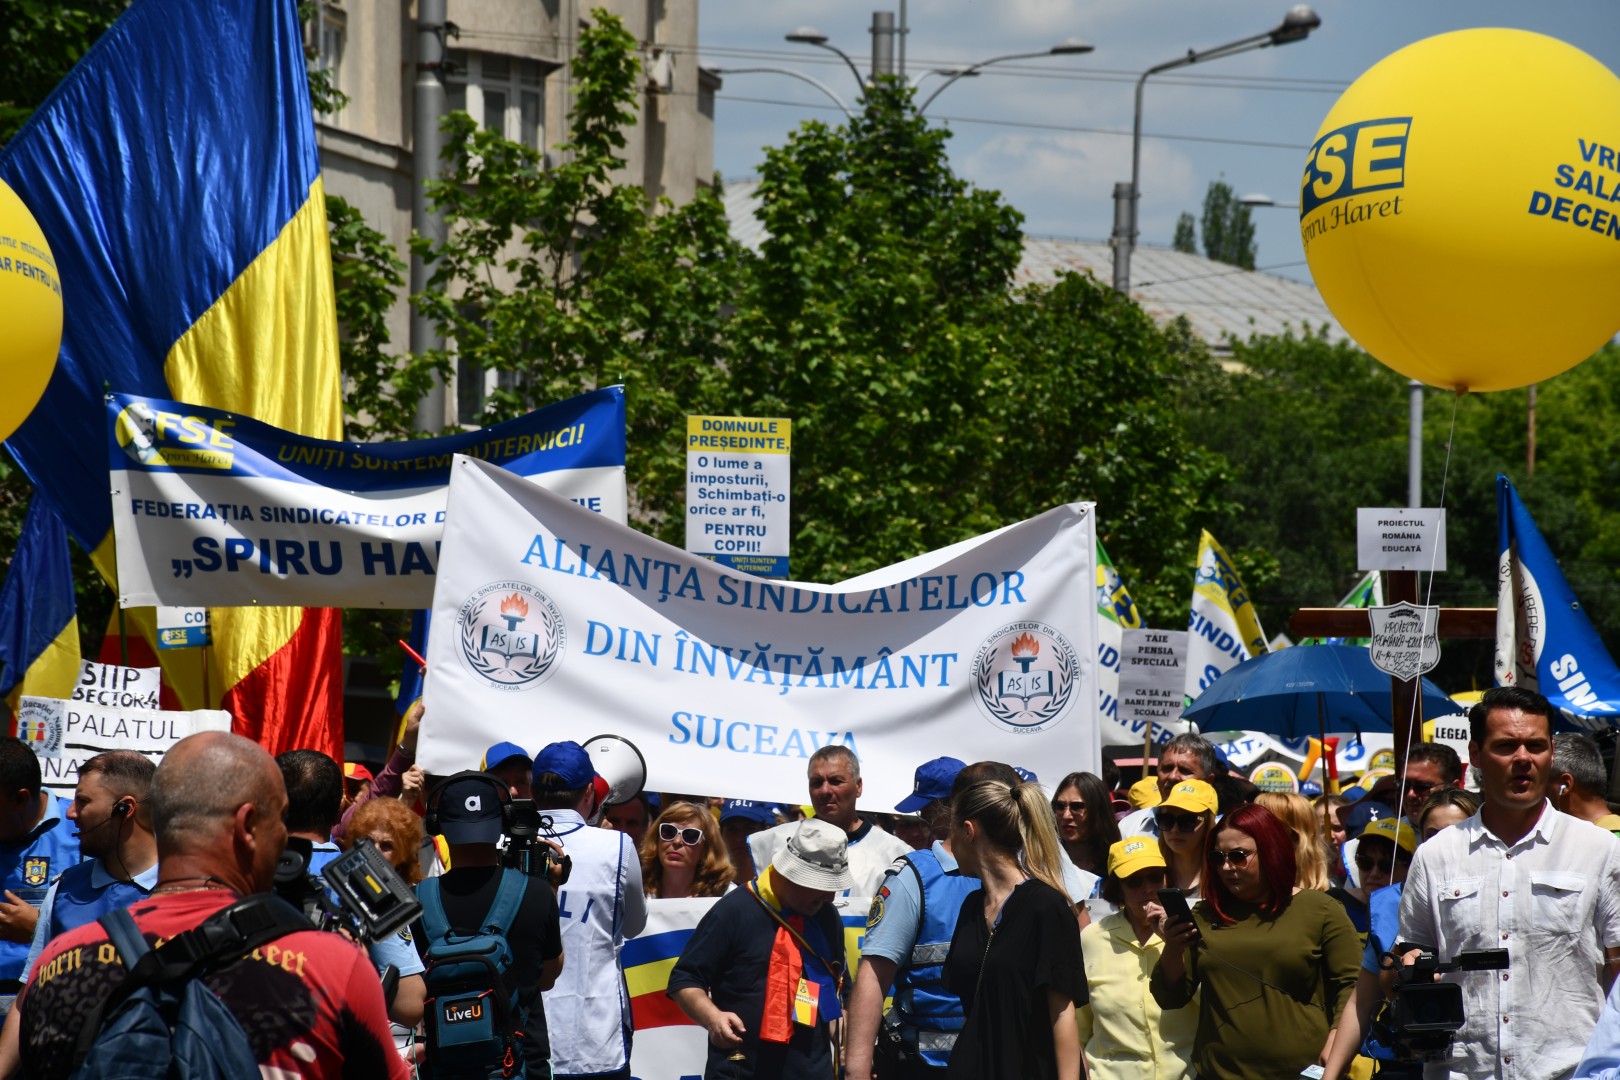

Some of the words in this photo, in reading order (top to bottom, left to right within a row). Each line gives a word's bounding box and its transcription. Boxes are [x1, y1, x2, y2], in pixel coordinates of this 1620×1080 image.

[1331, 196, 1404, 228] Haret
[156, 411, 236, 449] FSE
[702, 420, 778, 433] DOMNULE
[351, 452, 451, 471] SUNTEM
[698, 456, 708, 467] O
[713, 457, 749, 469] lume
[754, 461, 762, 470] a
[690, 472, 768, 488] imposturii,
[131, 499, 253, 526] FEDERAȚIA
[260, 505, 426, 528] SINDICATELOR
[690, 505, 727, 515] orice
[732, 507, 747, 516] ar
[751, 506, 765, 519] fi,
[705, 524, 766, 536] PENTRU
[715, 540, 761, 552] COPII!
[534, 591, 547, 602] DIN
[717, 570, 1027, 614] SINDICATELOR
[1042, 626, 1056, 637] DIN
[1145, 634, 1168, 643] TAIE
[490, 633, 507, 647] AS
[583, 620, 662, 667] DIN
[1138, 646, 1174, 655] PENSIA
[81, 662, 141, 691] SIIP
[1007, 676, 1022, 691] AS
[490, 682, 521, 691] SUCEAVA
[66, 711, 181, 740] PALATUL
[1012, 726, 1042, 734] SUCEAVA
[1435, 727, 1468, 740] LEGEA
[44, 757, 90, 778] NA
[730, 799, 752, 809] FSLI
[38, 947, 83, 988] born
